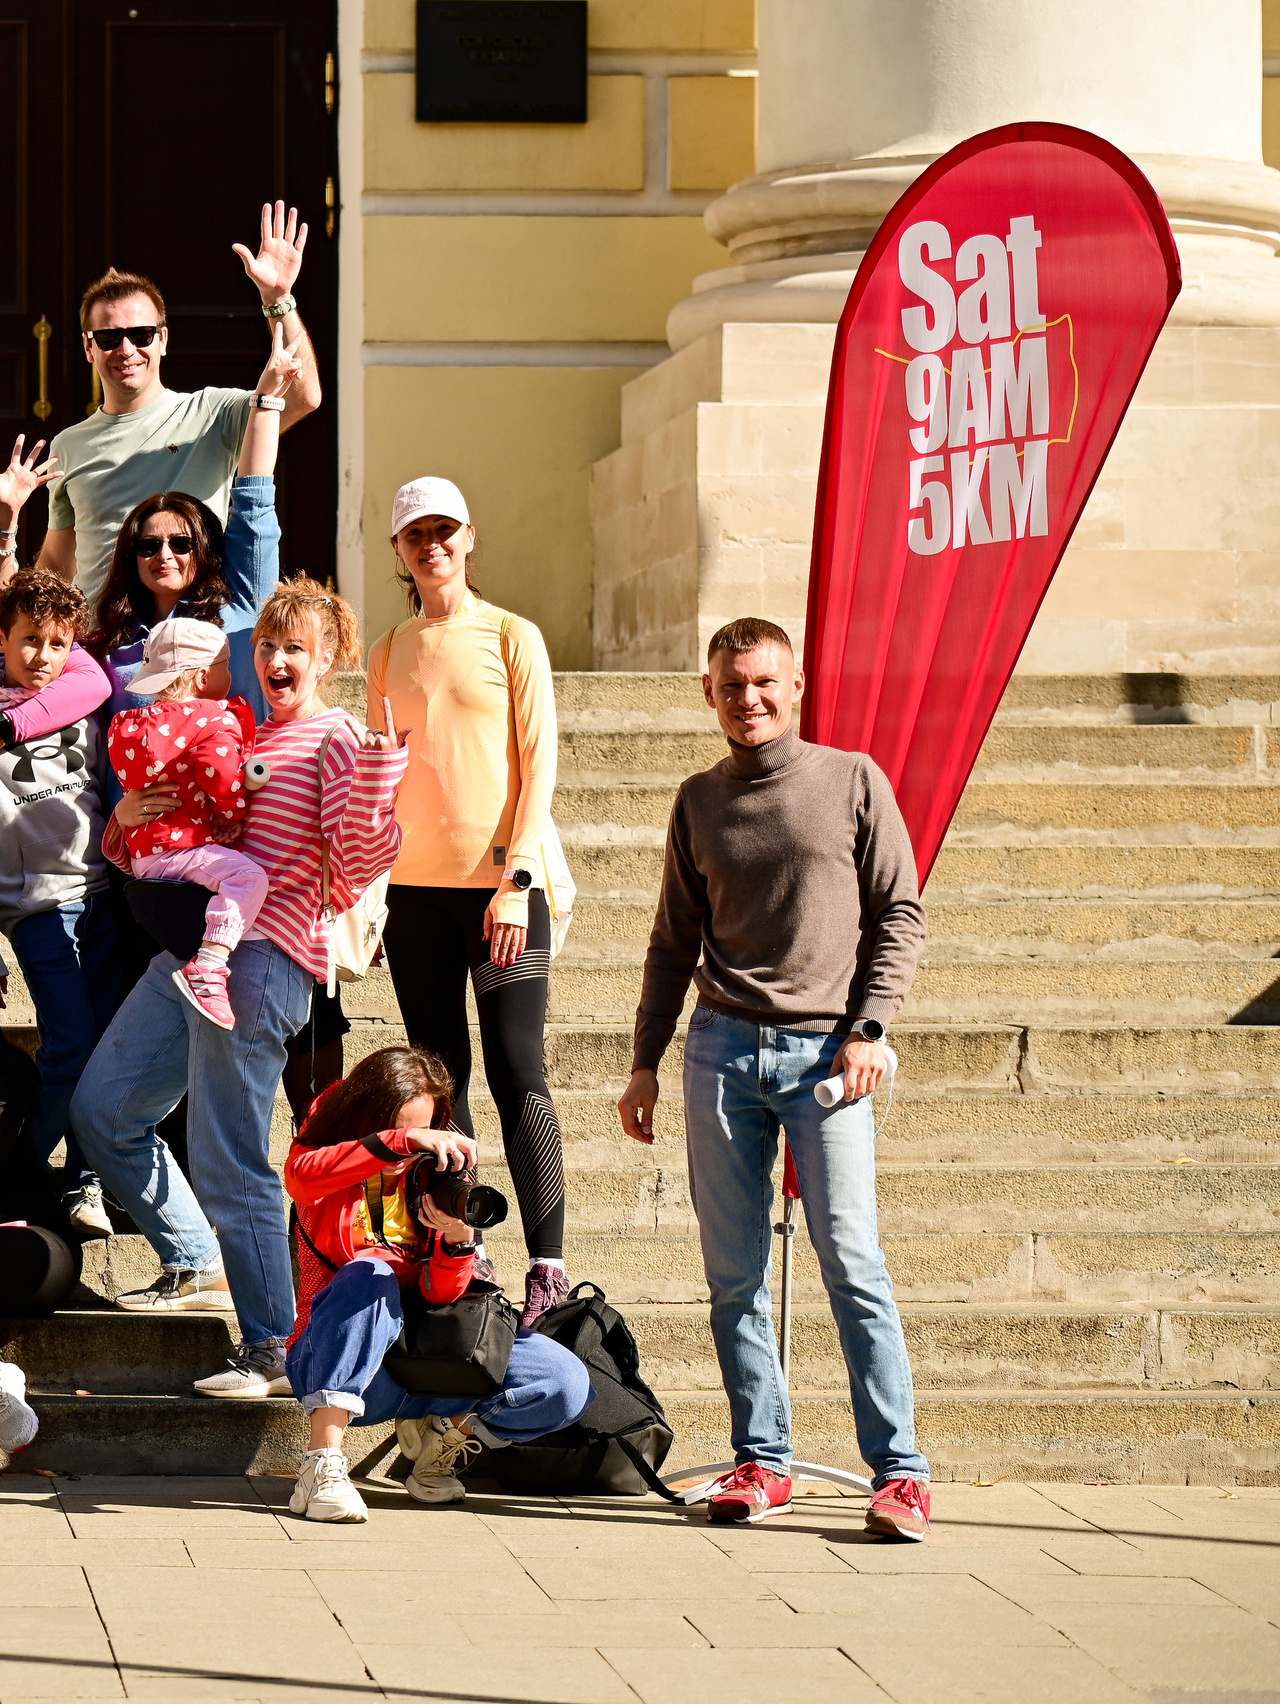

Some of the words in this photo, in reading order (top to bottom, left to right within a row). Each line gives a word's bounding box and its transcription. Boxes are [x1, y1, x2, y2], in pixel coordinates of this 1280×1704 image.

[898, 215, 1046, 354] Sat
[904, 336, 1049, 454] 9AM
[907, 439, 1049, 556] 5KM
[13, 788, 53, 806] UNDER
